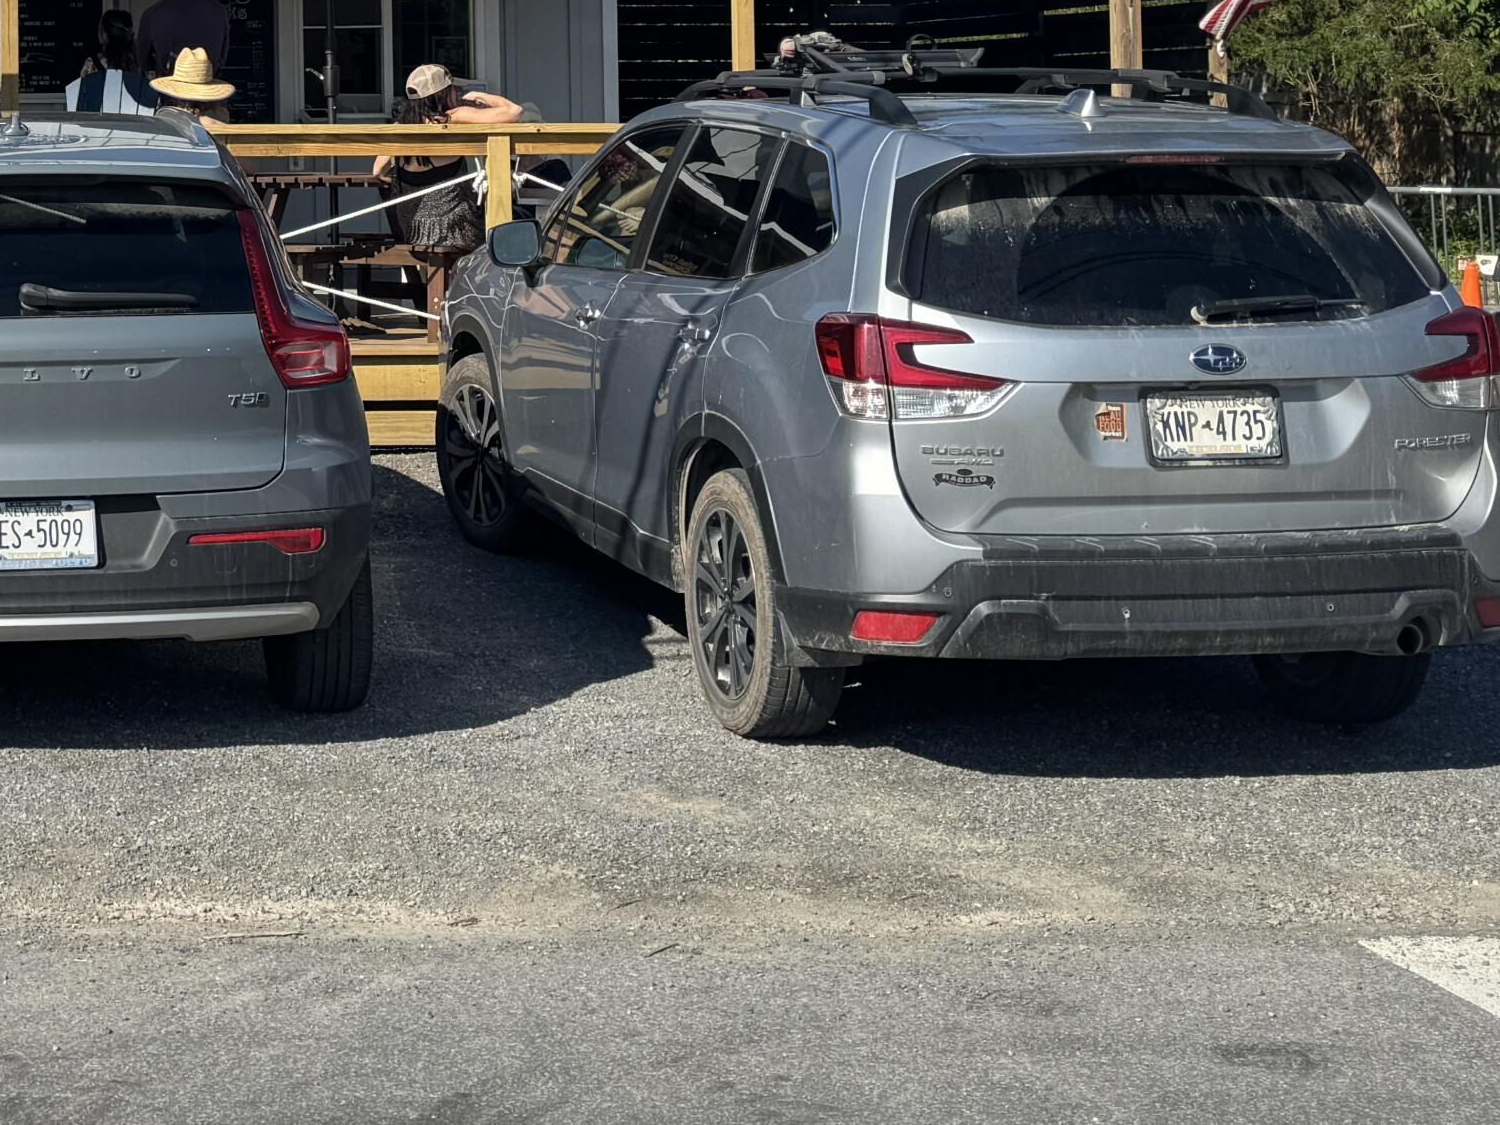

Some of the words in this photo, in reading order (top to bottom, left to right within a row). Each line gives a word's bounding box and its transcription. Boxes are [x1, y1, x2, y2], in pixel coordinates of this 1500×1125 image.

[1161, 410, 1199, 443] KNP
[1215, 409, 1266, 442] 4735
[1394, 432, 1471, 449] FORESTER
[920, 444, 1005, 458] SUBARU
[941, 473, 988, 484] HADDAD
[4, 507, 30, 517] NEW
[34, 506, 65, 517] YORK
[36, 518, 83, 548] 5099
